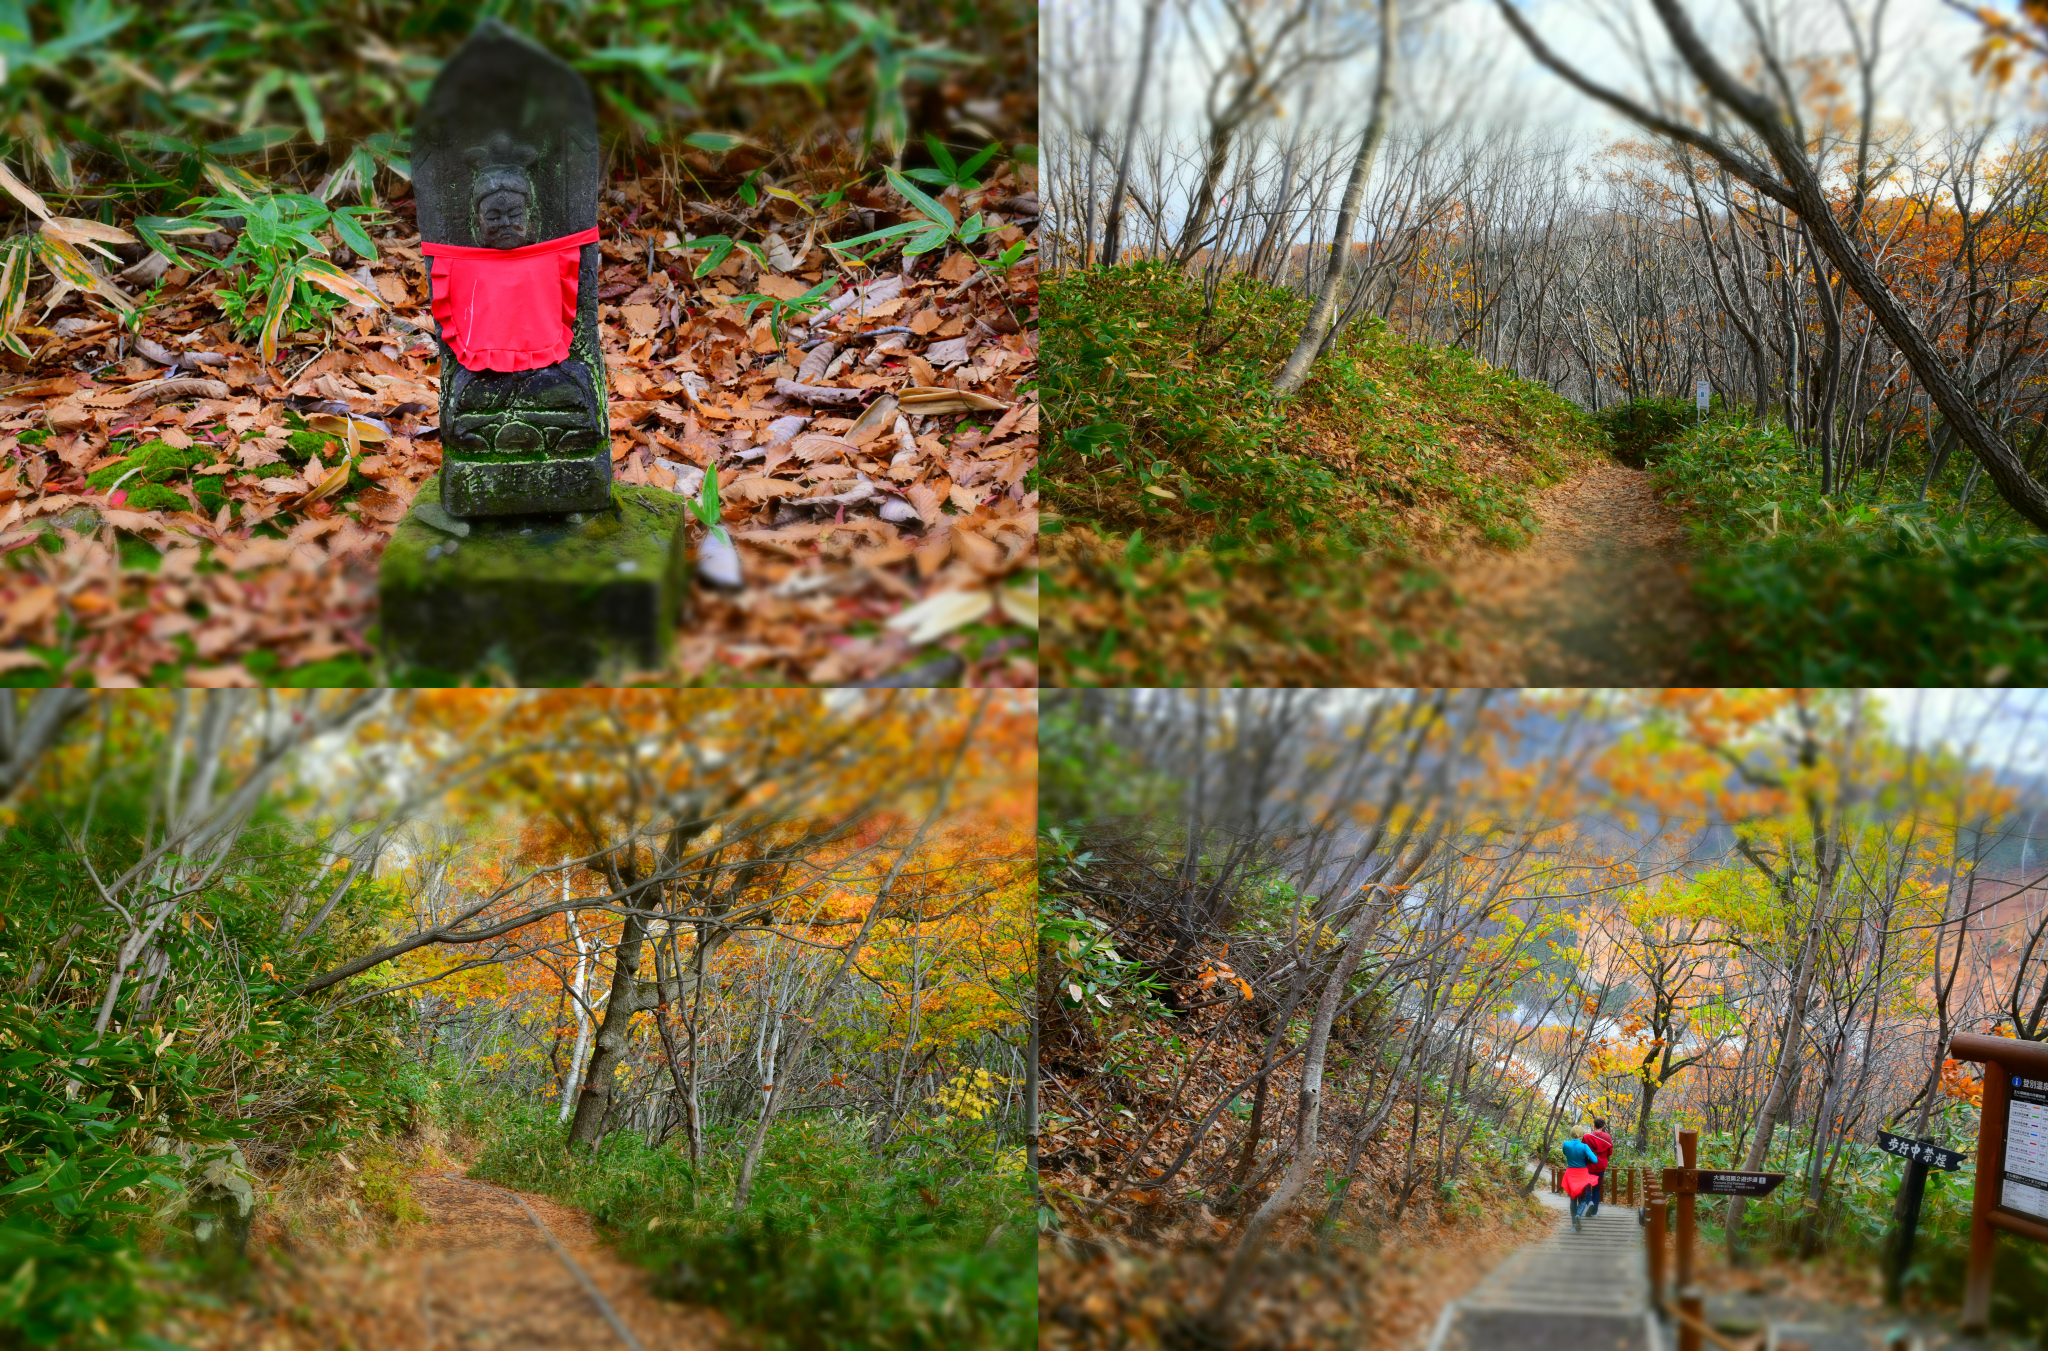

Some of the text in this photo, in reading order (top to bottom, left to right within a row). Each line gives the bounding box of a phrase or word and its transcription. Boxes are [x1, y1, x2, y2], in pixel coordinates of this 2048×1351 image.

[1888, 1137, 1947, 1168] 歩行中禁煙
